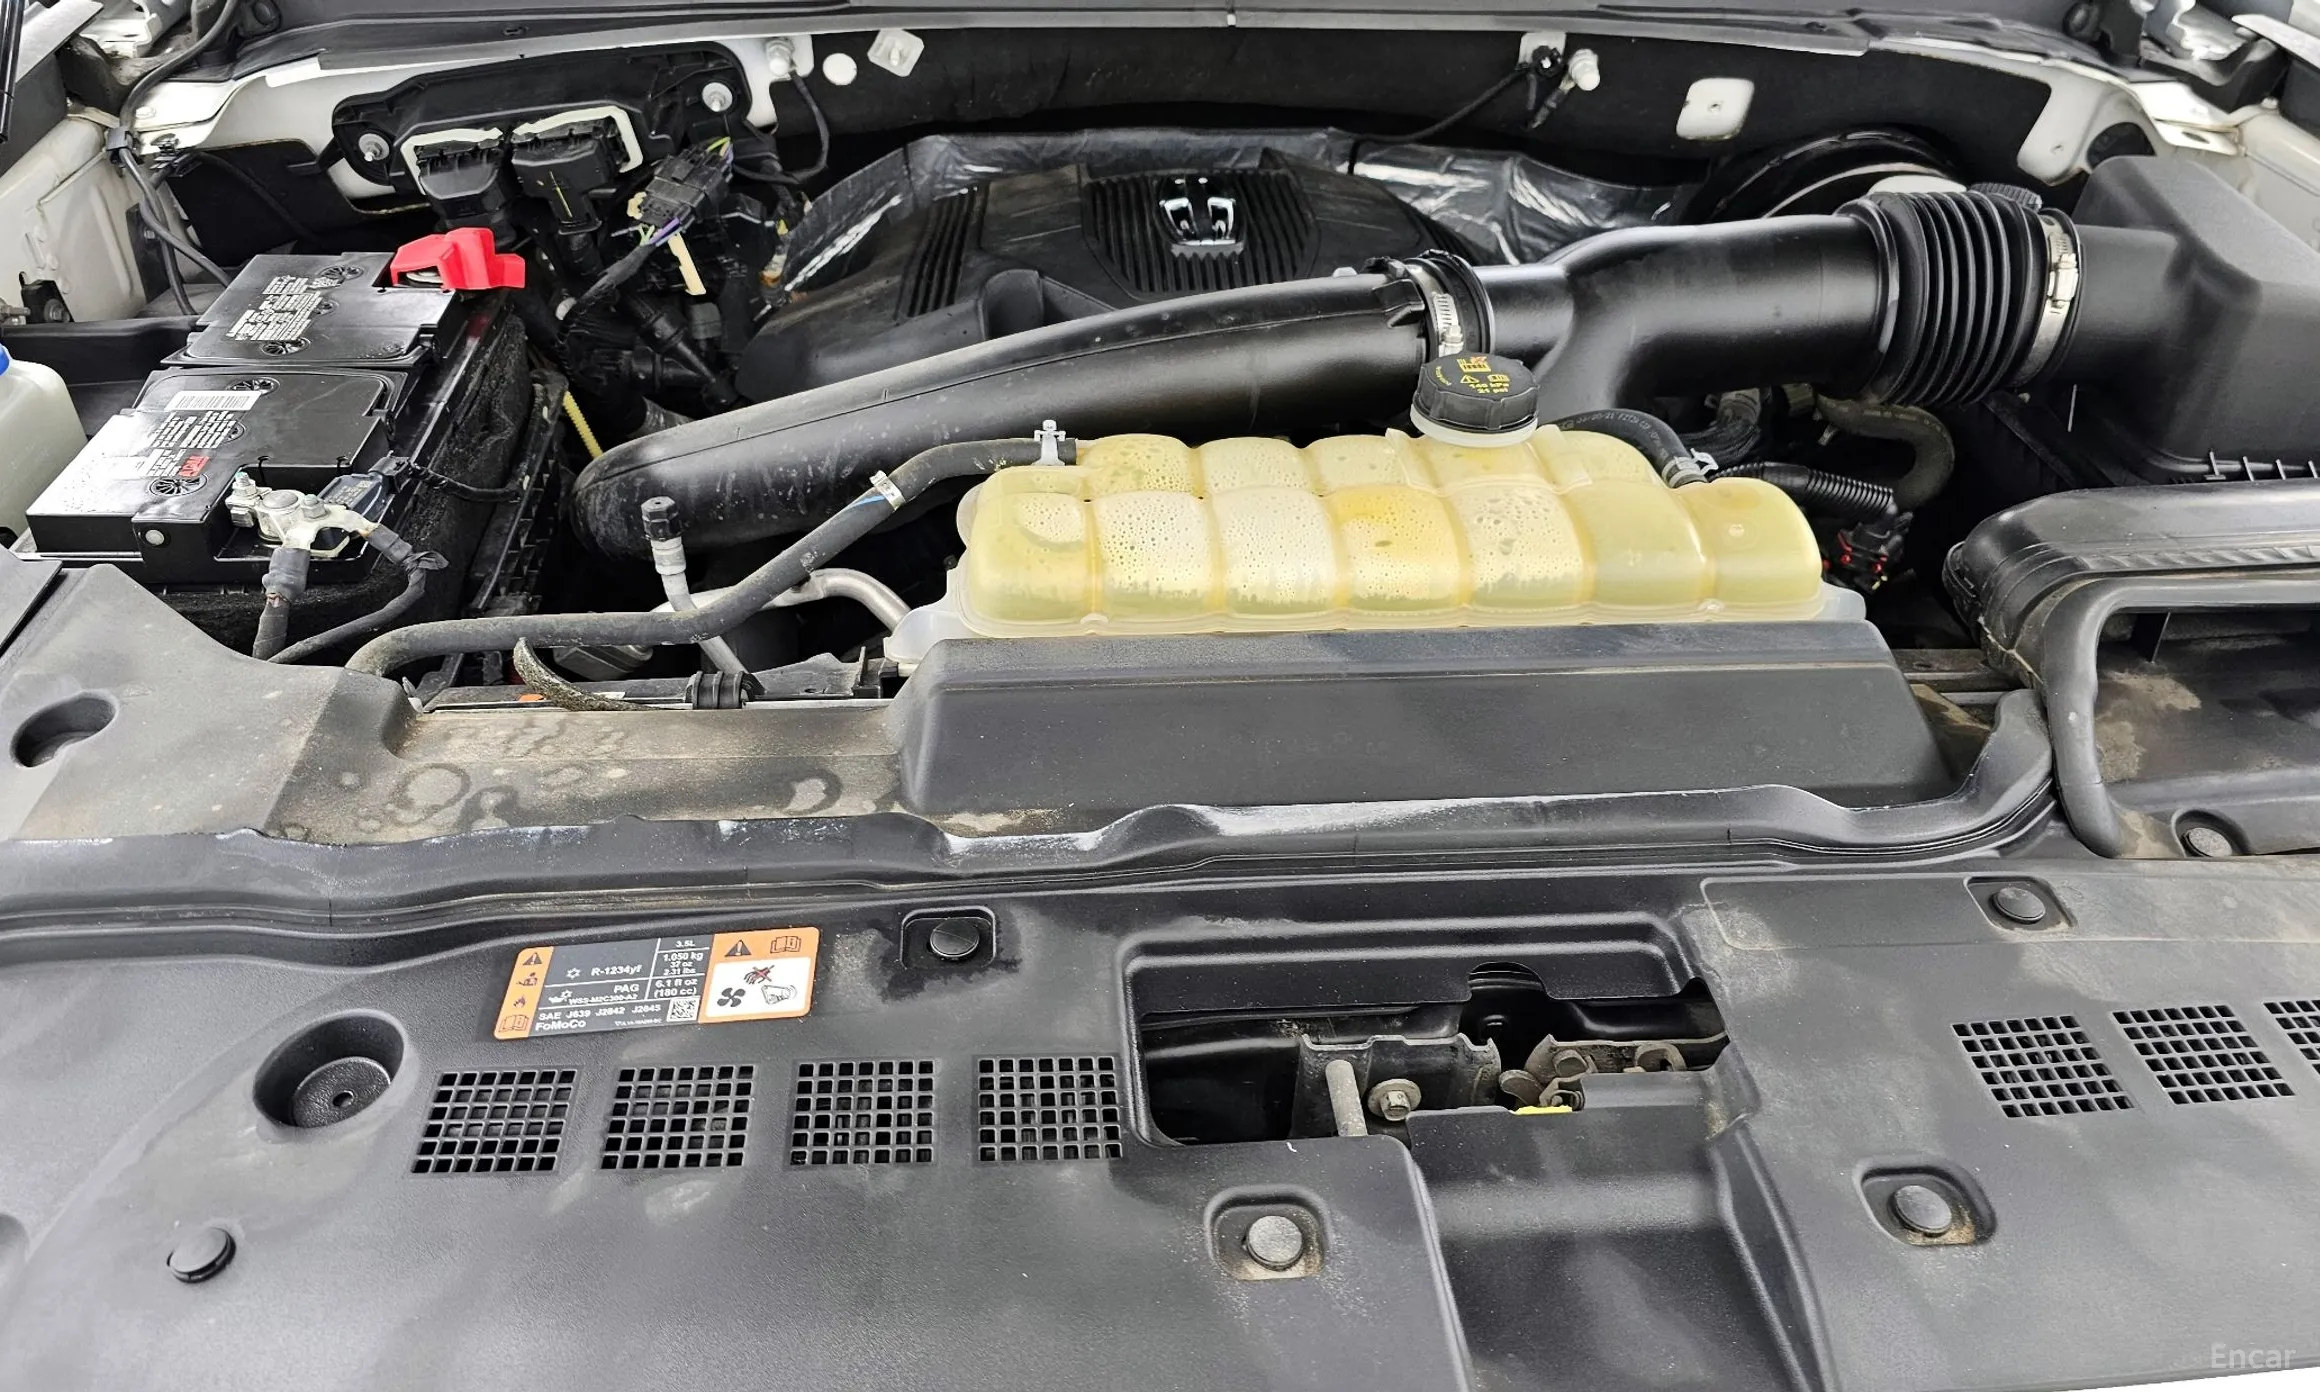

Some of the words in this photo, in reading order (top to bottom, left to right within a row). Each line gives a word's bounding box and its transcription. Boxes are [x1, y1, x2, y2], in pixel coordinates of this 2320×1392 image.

[675, 940, 696, 948] 3.5L
[663, 952, 689, 962] 1.050
[690, 951, 704, 962] kg
[591, 964, 643, 976] R-1234yf
[613, 983, 640, 994] PAG
[655, 979, 672, 988] 6.1
[684, 978, 698, 986] oz
[653, 988, 678, 999] (180
[679, 986, 697, 996] cc)
[539, 1012, 561, 1020] SAE
[535, 1019, 586, 1030] FoMoCo
